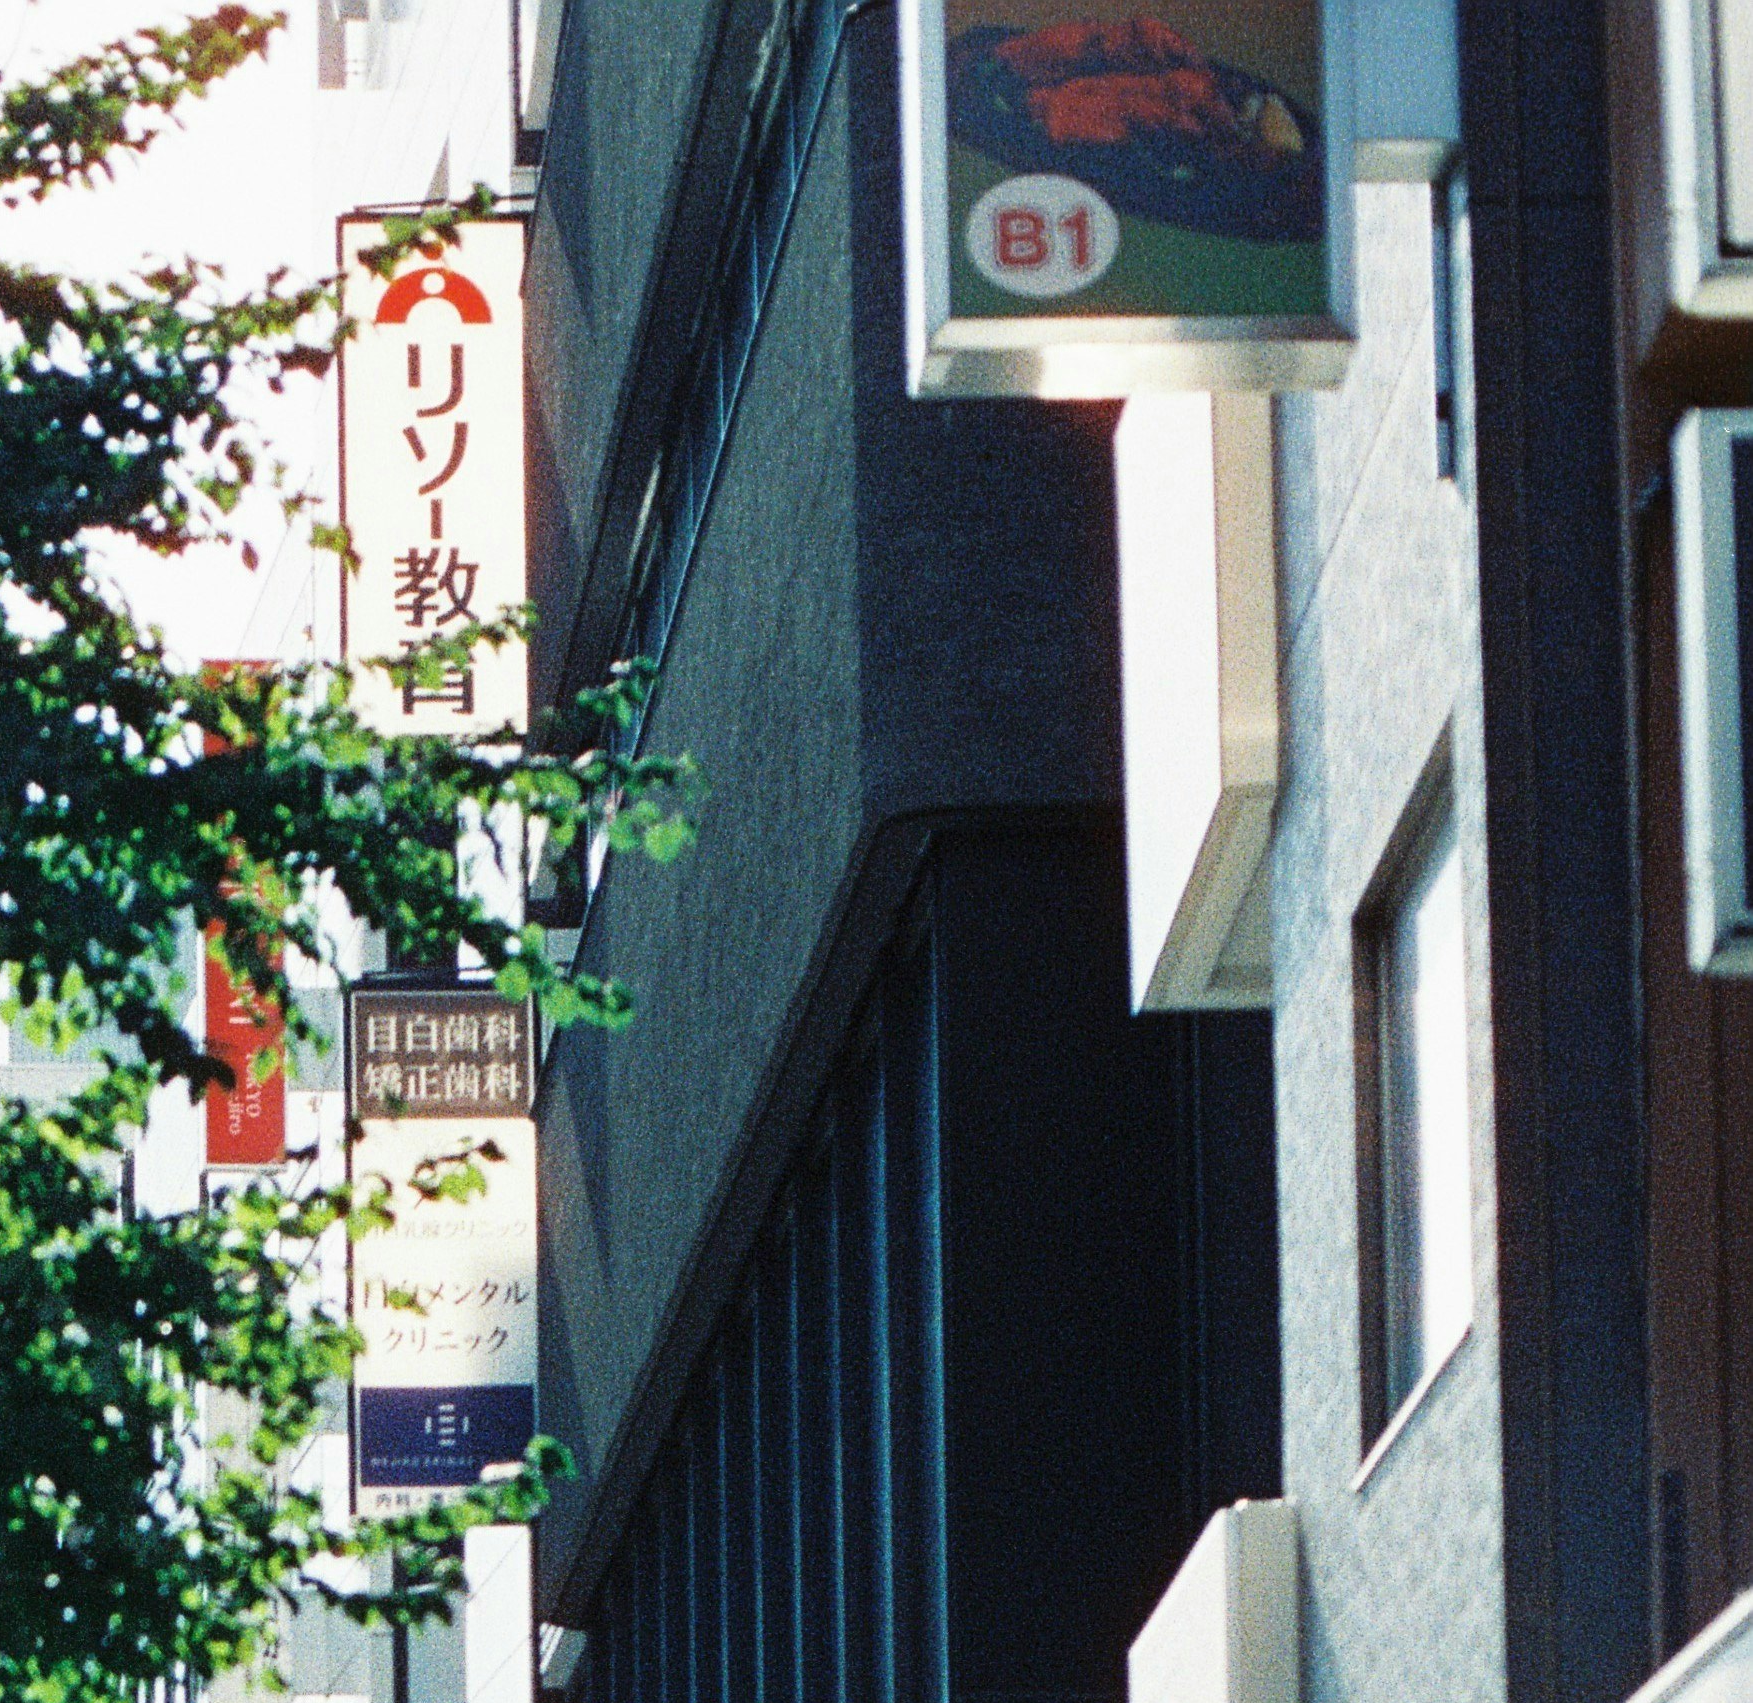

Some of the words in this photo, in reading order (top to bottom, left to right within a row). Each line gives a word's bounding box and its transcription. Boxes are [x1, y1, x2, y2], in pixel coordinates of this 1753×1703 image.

[992, 208, 1091, 271] B1
[367, 1013, 524, 1053] 目白歯科
[382, 1326, 510, 1354] クリニック
